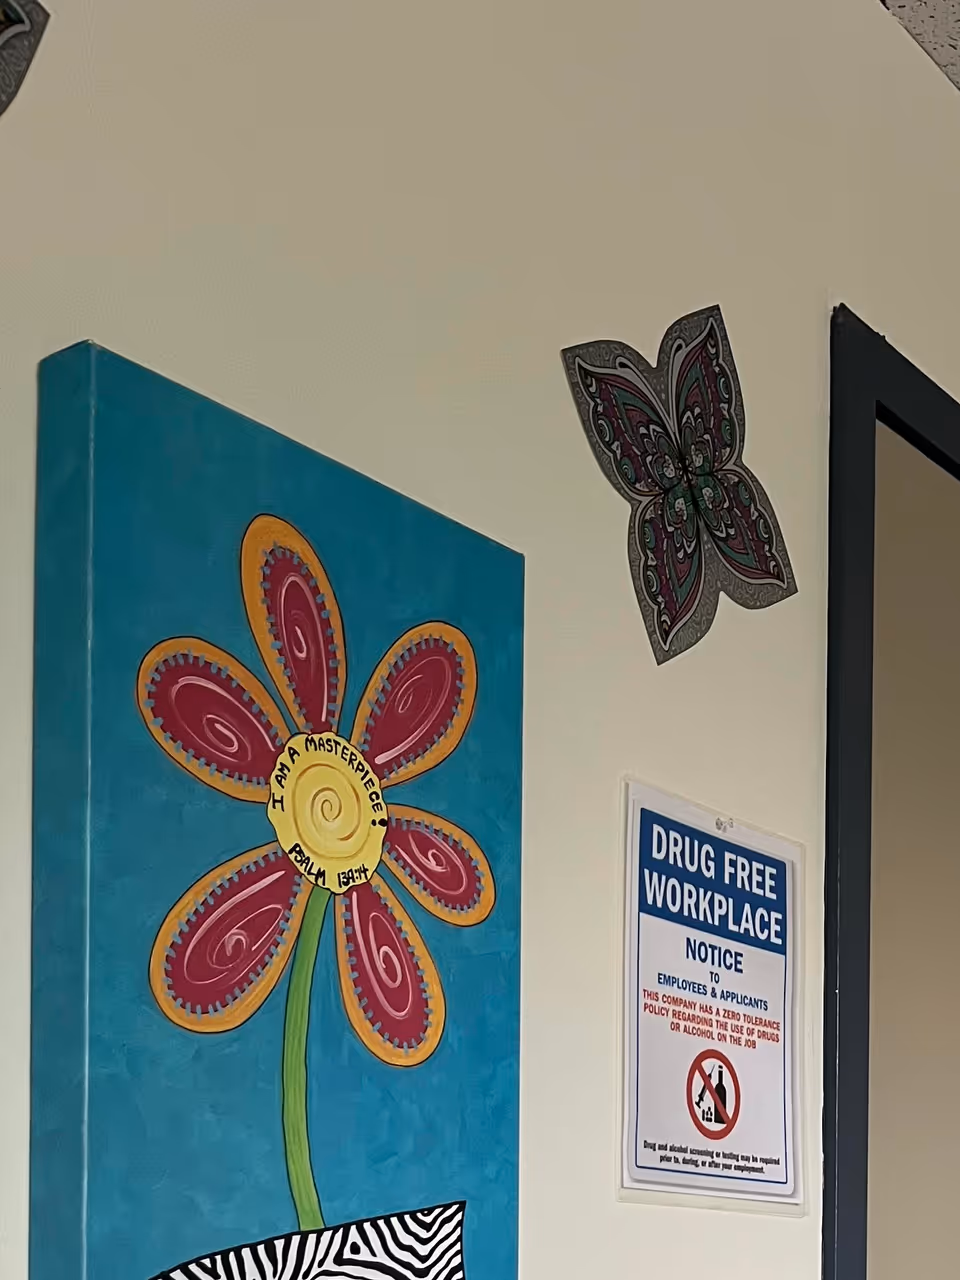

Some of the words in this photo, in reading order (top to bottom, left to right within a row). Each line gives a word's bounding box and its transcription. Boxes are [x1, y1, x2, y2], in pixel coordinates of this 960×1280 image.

[288, 746, 300, 764] A
[275, 762, 291, 789] AM
[272, 793, 285, 812] I
[288, 842, 326, 886] PSALM
[652, 823, 715, 880] DRUG
[724, 851, 777, 900] FREE
[643, 868, 782, 945] WORKPLACE
[686, 937, 743, 973] NOTICE
[657, 973, 707, 996] EMPLOYEES
[711, 987, 717, 998] &
[720, 989, 768, 1011] APPLICANTS
[709, 971, 720, 984] TO
[643, 989, 659, 1002] THIS
[662, 994, 697, 1011] COMPANY
[699, 1004, 713, 1015] HAS
[715, 1007, 721, 1017] A
[722, 1008, 740, 1021] ZERO
[743, 1015, 780, 1031] TOLERANCE
[644, 1003, 669, 1017] POLICY
[672, 1009, 713, 1028] REGARDING
[715, 1019, 728, 1031] THE
[730, 1023, 744, 1035] USE
[746, 1027, 755, 1037] OF
[757, 1029, 780, 1043] DRUGS
[670, 1021, 681, 1032] OR
[683, 1023, 714, 1041] ALCOHOL
[717, 1032, 727, 1042] ON
[729, 1034, 742, 1046] THE
[744, 1037, 756, 1049] JOB
